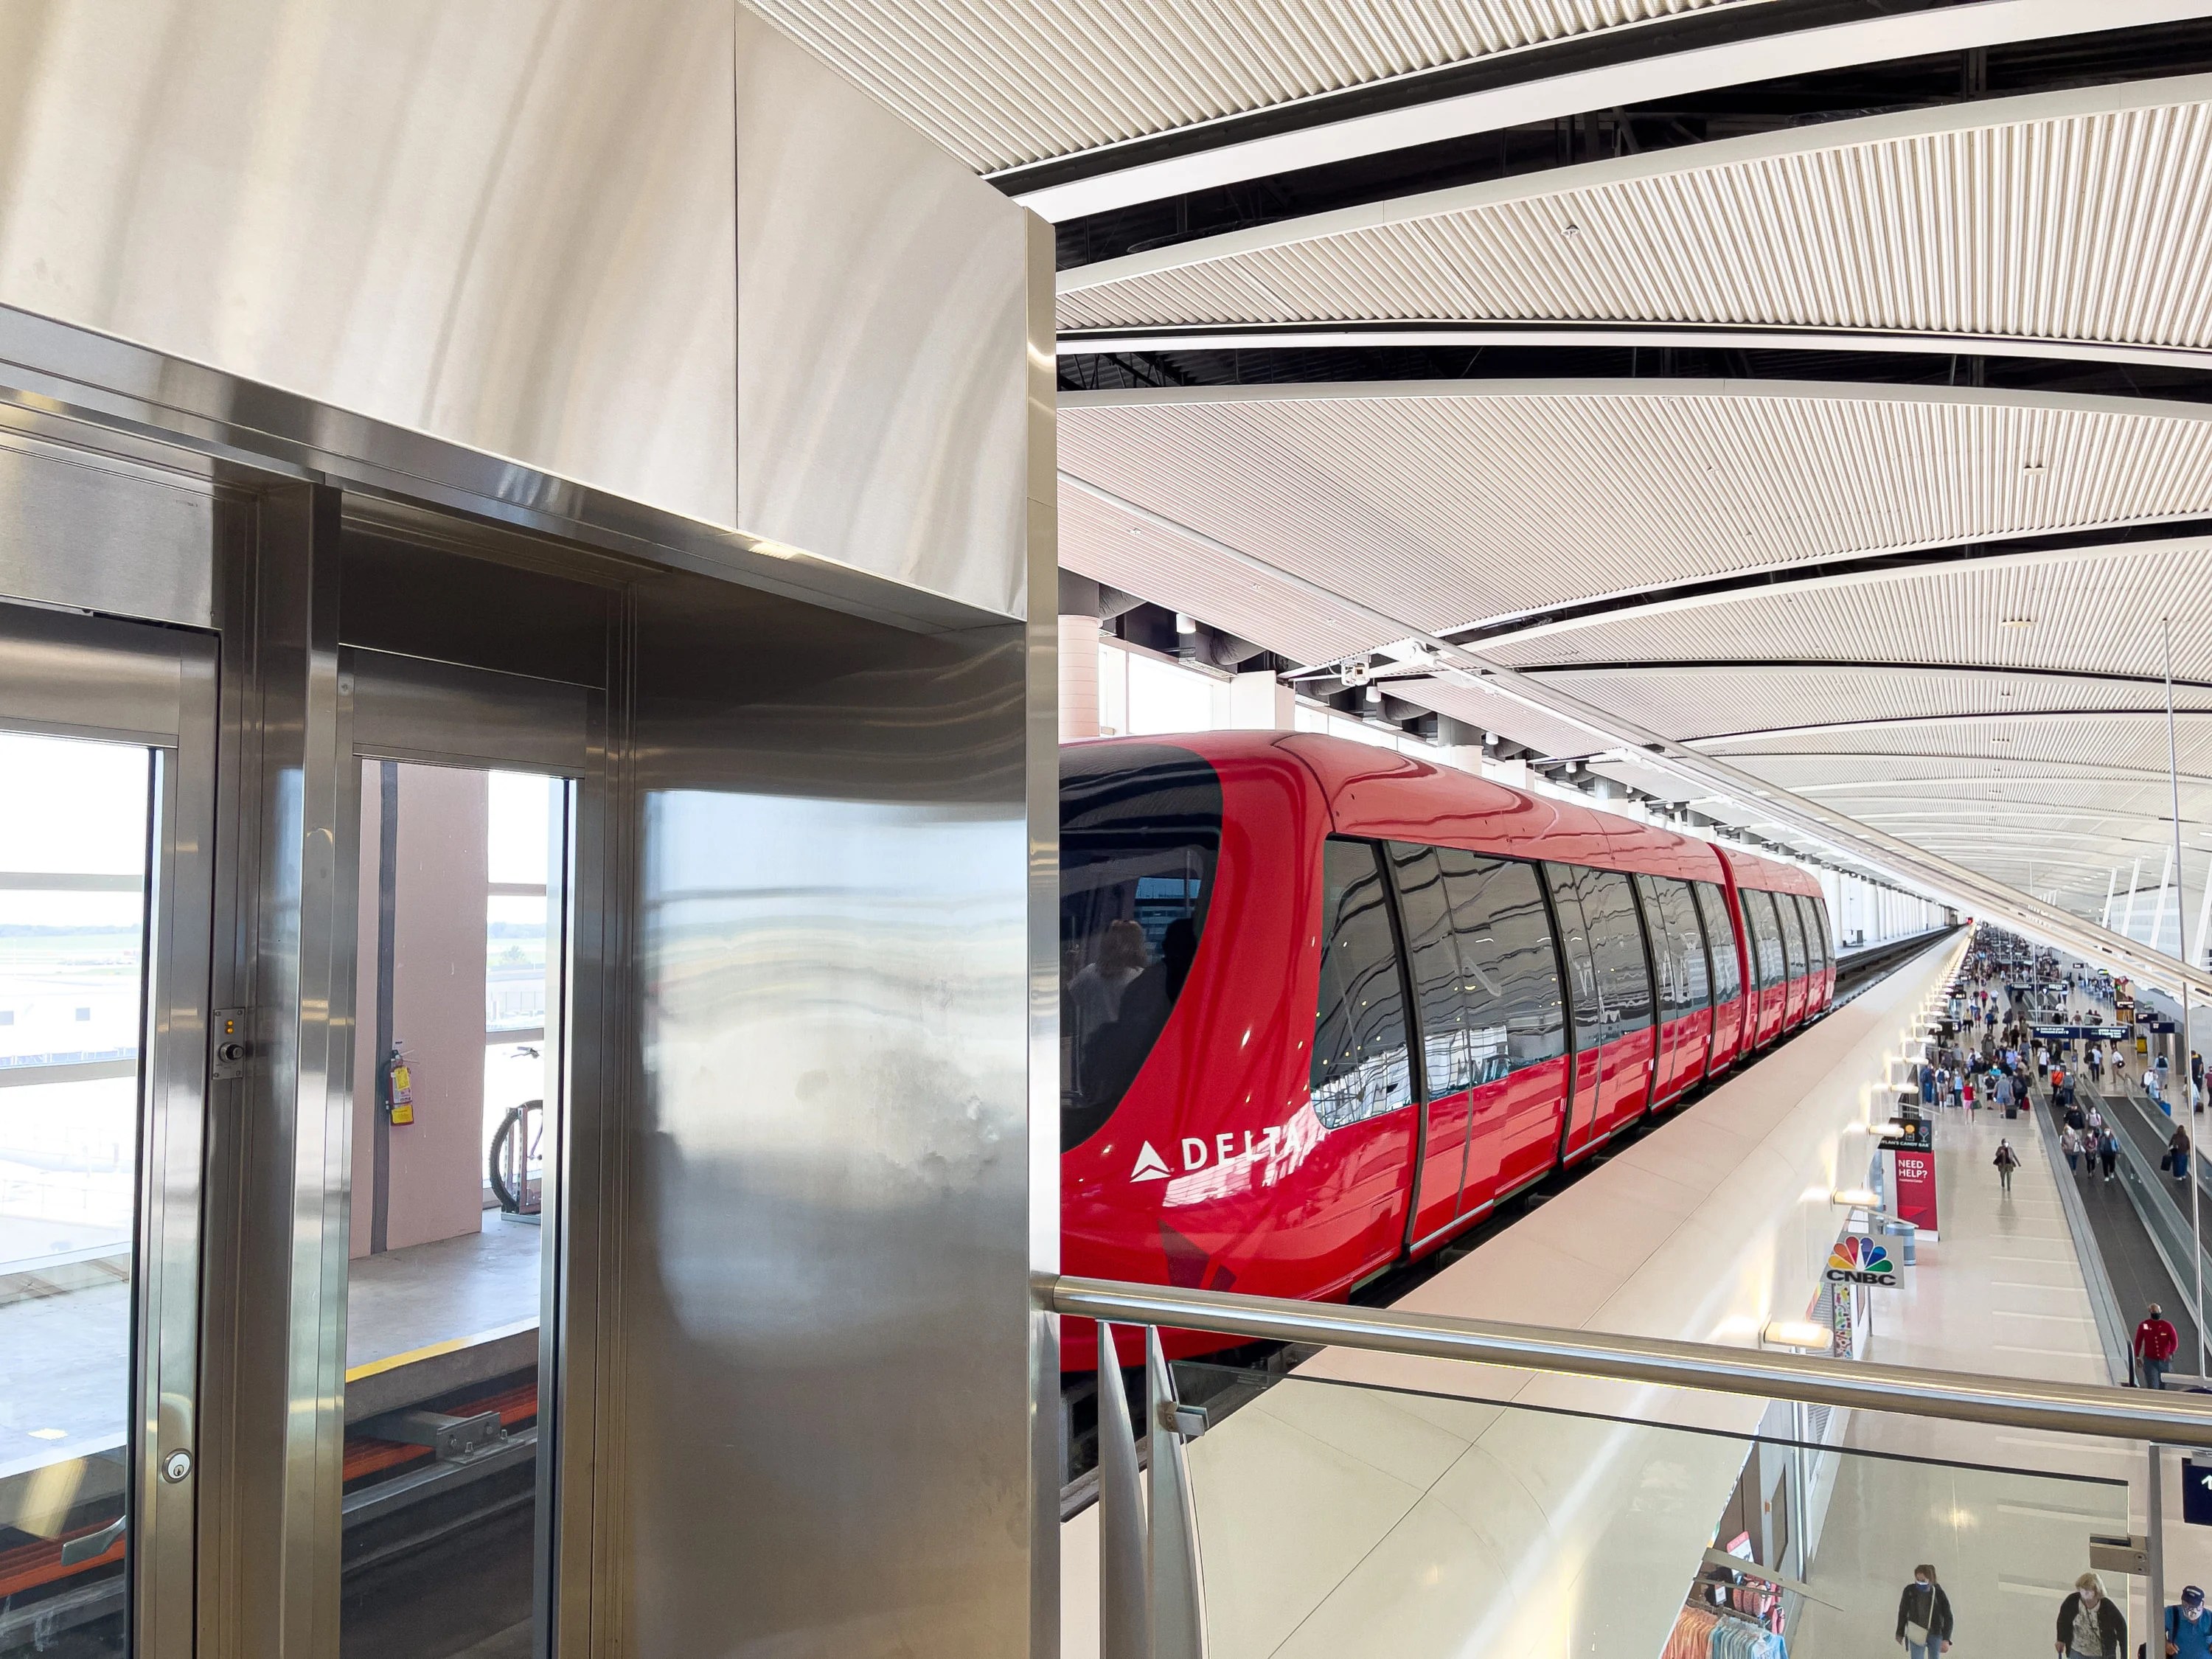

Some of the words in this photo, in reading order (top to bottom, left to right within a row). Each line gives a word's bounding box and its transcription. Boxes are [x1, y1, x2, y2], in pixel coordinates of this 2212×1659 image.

[1181, 1123, 1301, 1171] DELTA
[1898, 1159, 1924, 1169] NEED
[1899, 1169, 1928, 1178] HELP?
[1826, 1269, 1896, 1286] CNBC
